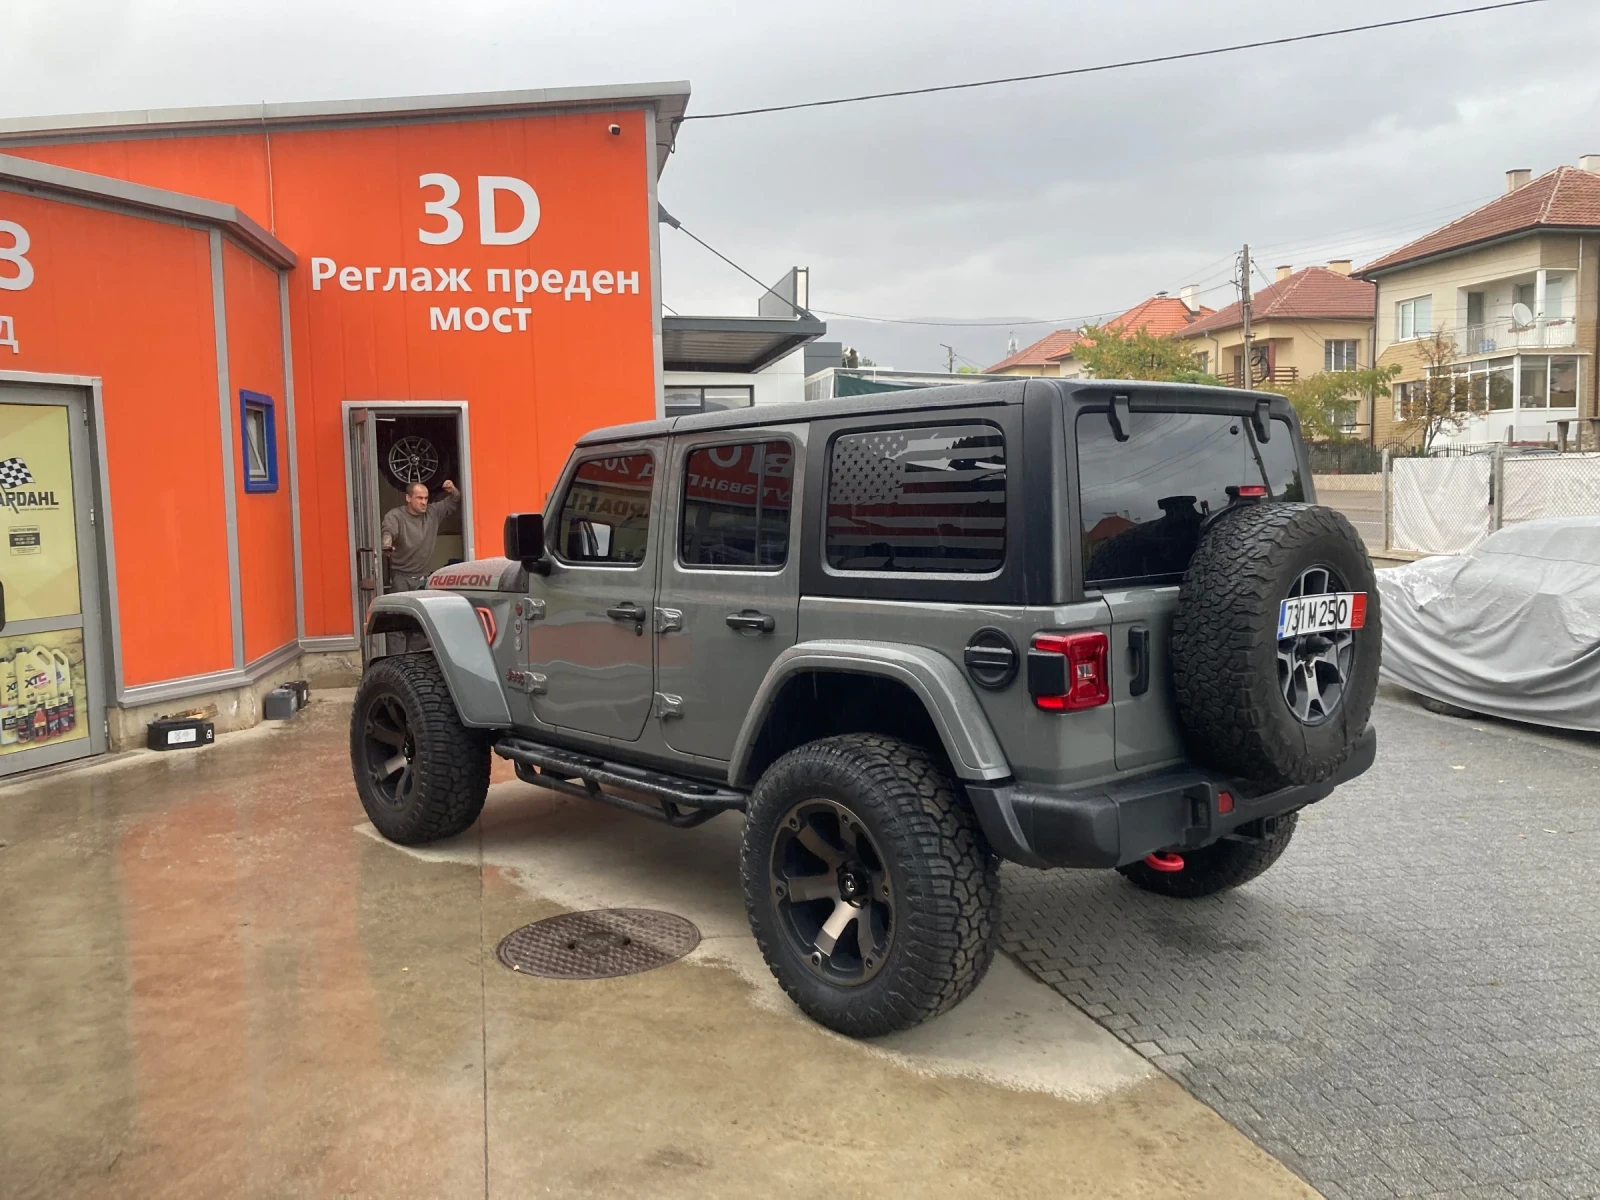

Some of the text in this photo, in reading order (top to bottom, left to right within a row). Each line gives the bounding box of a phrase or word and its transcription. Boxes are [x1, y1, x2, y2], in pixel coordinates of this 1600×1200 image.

[418, 173, 541, 245] 3D
[311, 257, 640, 303] Реглаж преден
[429, 306, 532, 333] мост
[429, 574, 493, 587] RUBICON
[1285, 602, 1305, 633] 731
[1319, 598, 1348, 627] 250
